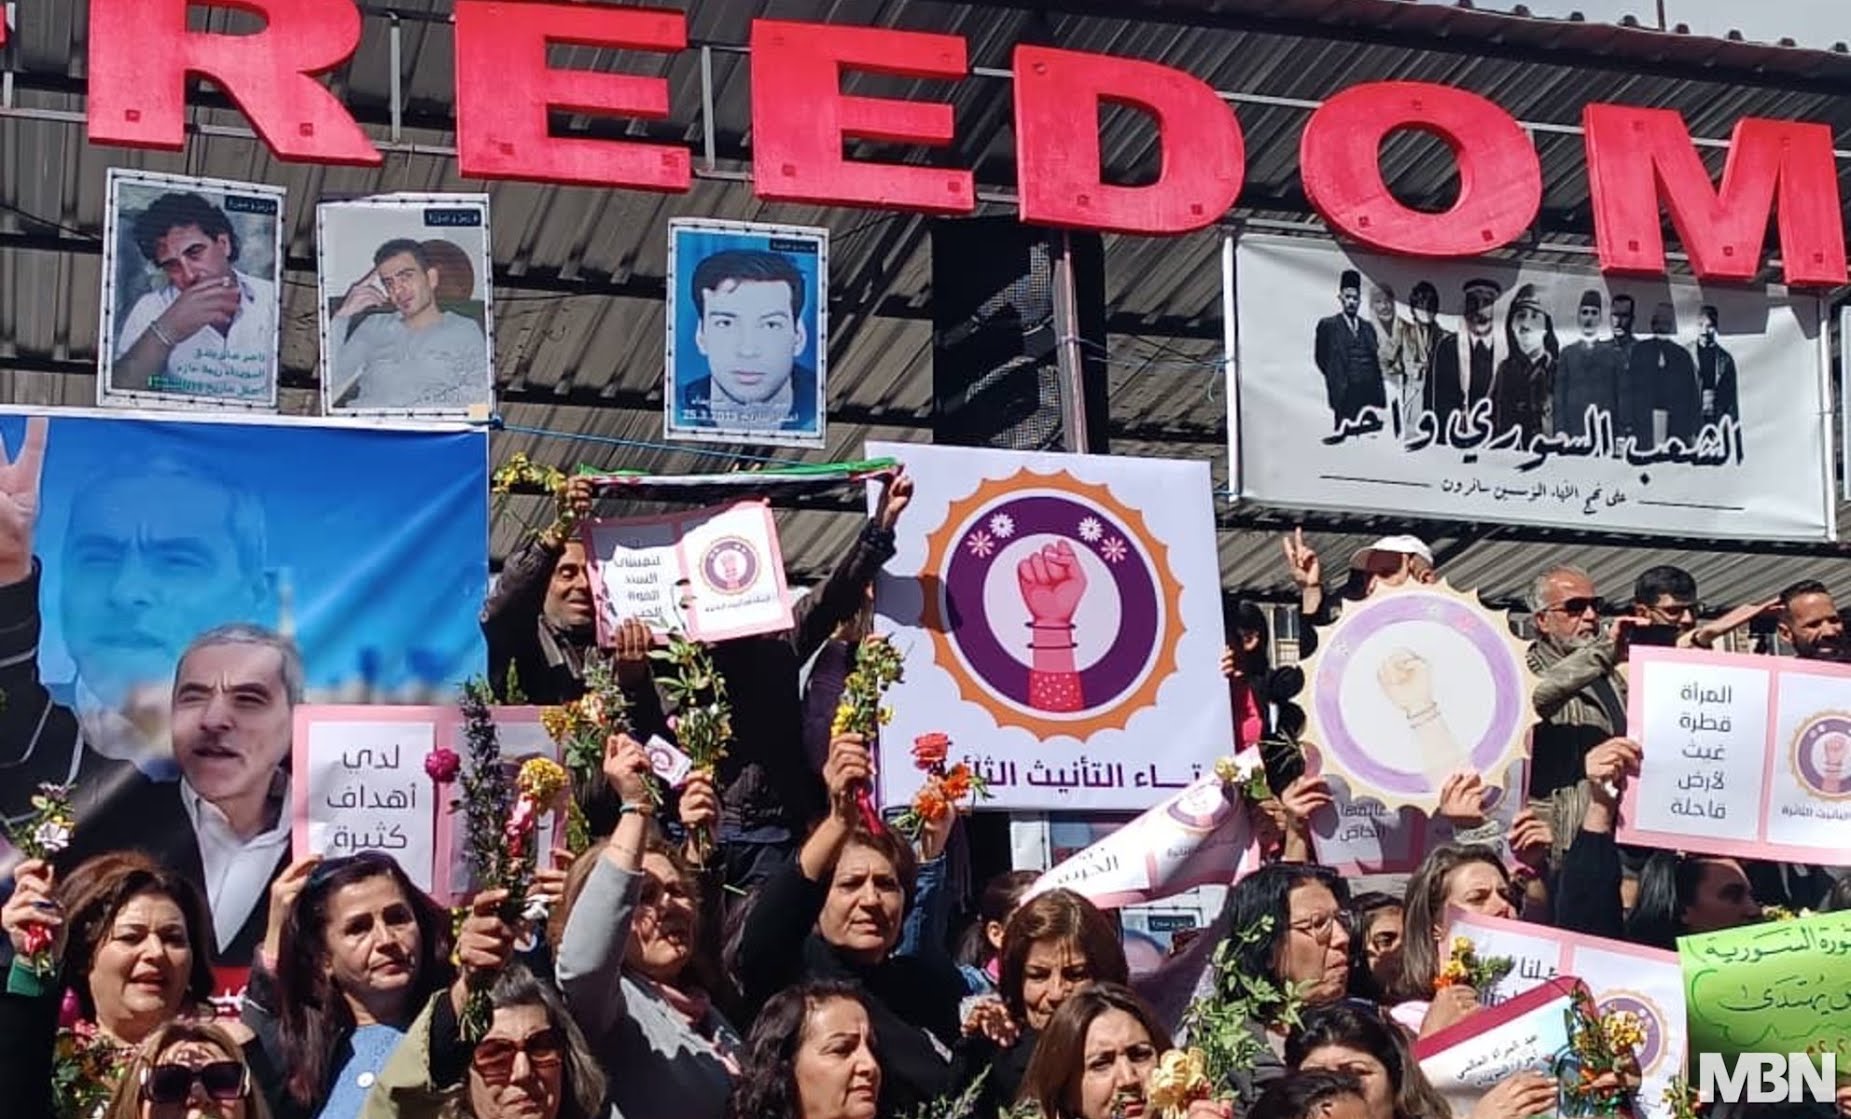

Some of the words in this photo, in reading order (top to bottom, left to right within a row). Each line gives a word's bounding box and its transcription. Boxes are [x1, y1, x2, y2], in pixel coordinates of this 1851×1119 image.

[0, 0, 1849, 287] REEDOM
[1321, 397, 1438, 452] واحد
[1447, 397, 1612, 473] السوري
[1624, 414, 1744, 486] الشعب
[1680, 681, 1732, 705] المرأة
[1679, 711, 1732, 733] قطرة
[343, 744, 399, 774] لدي
[1682, 738, 1727, 762] غيث
[1026, 755, 1124, 794] التأنيث
[1678, 770, 1724, 792] لأرض
[327, 782, 416, 809] أهداف
[1671, 797, 1727, 820] قاحلة
[334, 821, 407, 853] كثيرة
